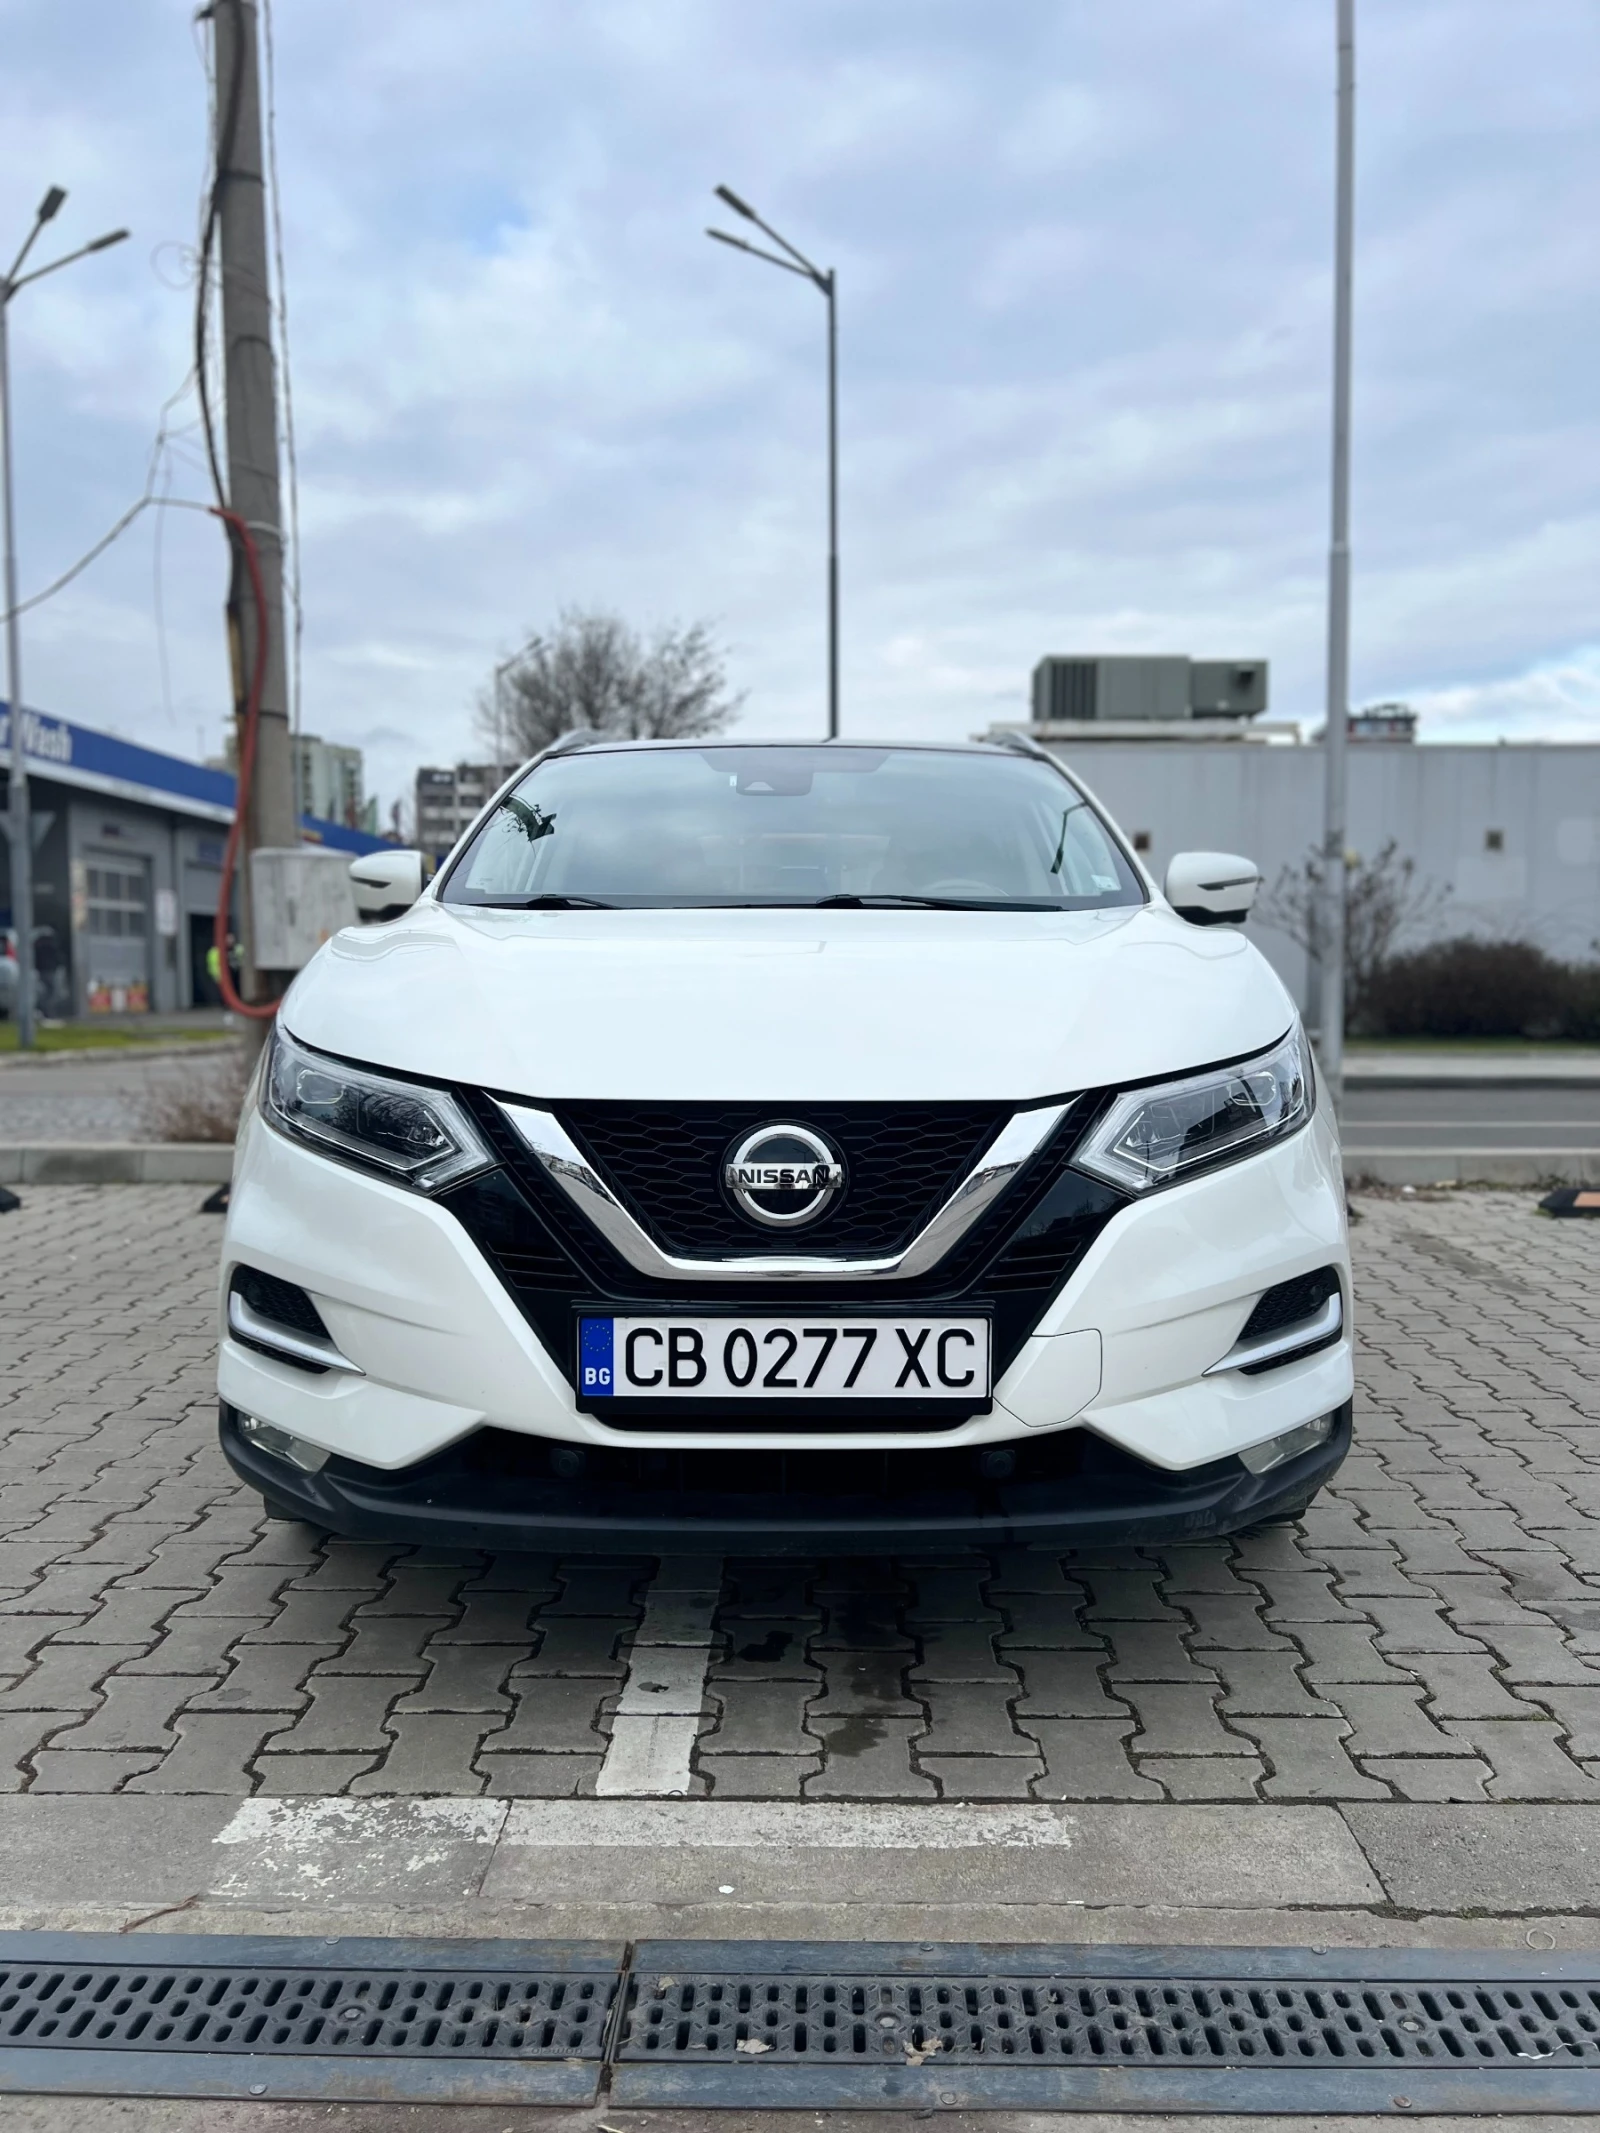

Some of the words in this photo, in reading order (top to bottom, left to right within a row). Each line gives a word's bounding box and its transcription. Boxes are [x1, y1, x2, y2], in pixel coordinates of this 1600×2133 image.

[21, 712, 72, 763] Wash
[738, 1169, 829, 1184] NISSAN
[625, 1327, 707, 1388] CB
[723, 1327, 878, 1388] 0277
[894, 1328, 976, 1388] XC
[585, 1367, 611, 1386] BG
